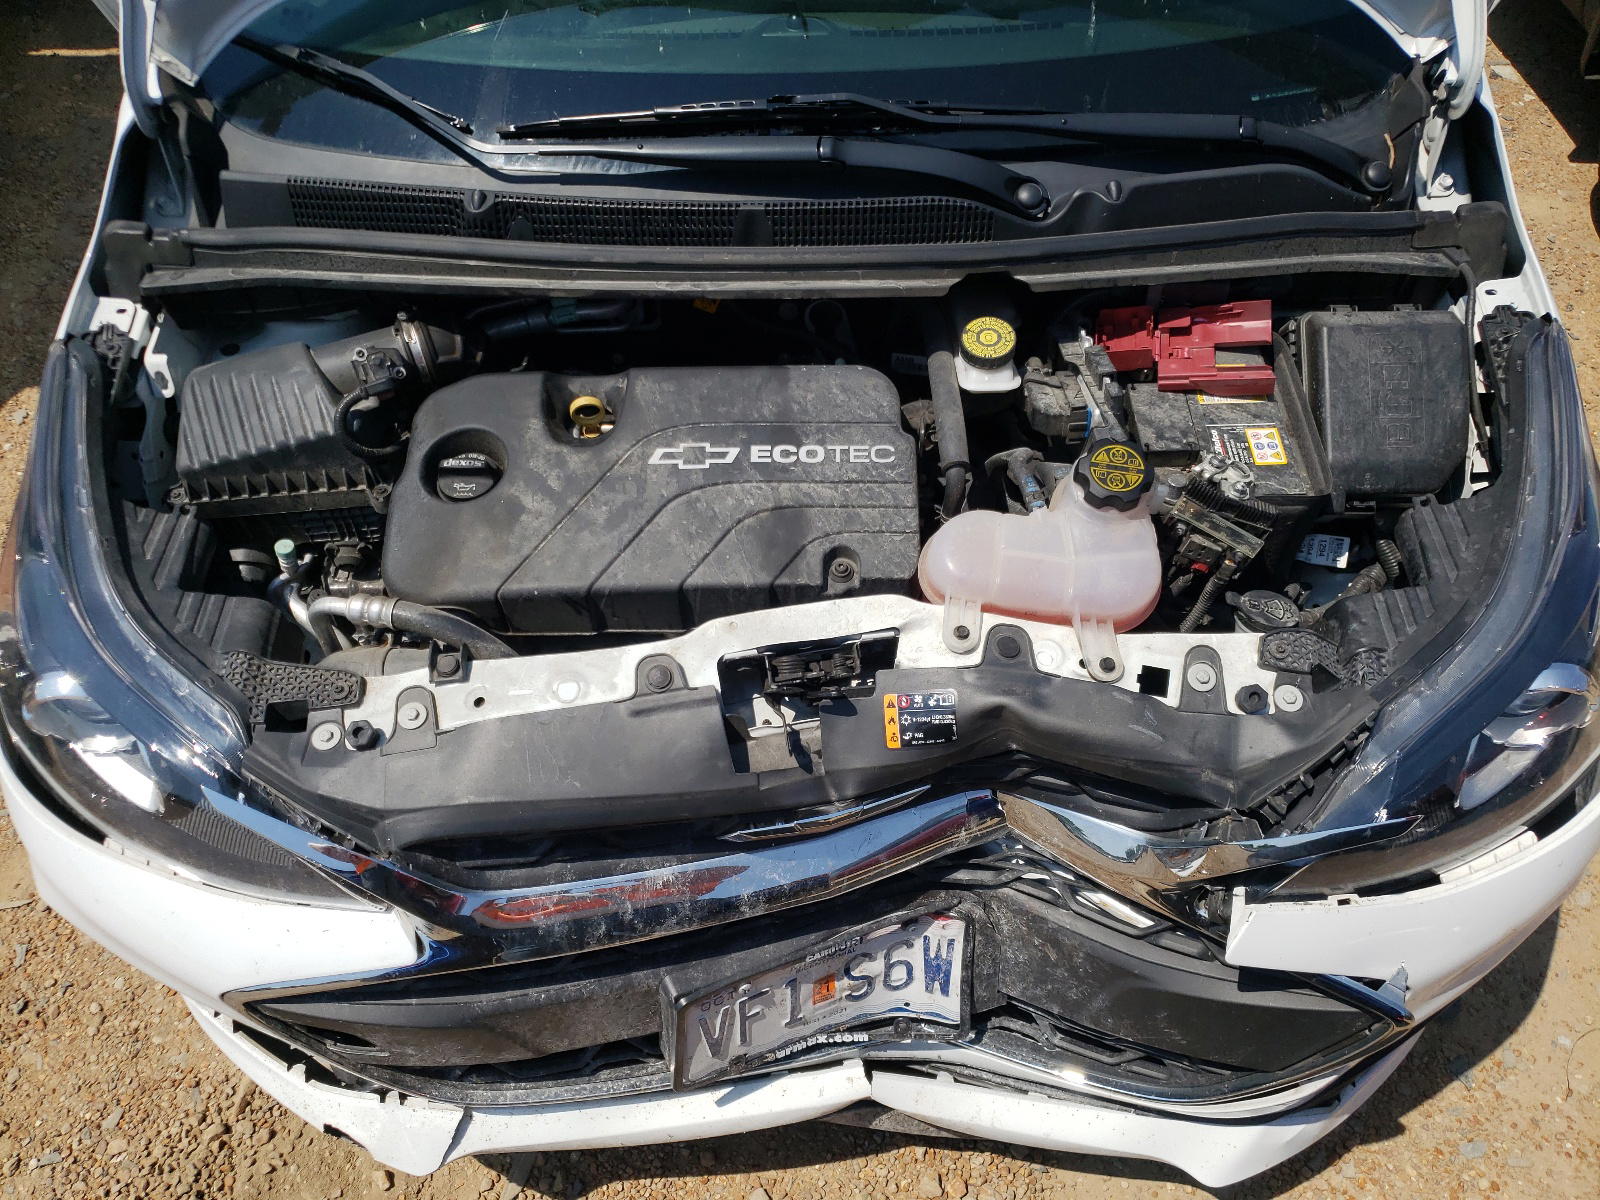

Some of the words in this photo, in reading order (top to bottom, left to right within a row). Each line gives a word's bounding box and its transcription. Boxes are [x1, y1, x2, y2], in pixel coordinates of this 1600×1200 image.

[443, 458, 484, 467] dexos
[751, 444, 896, 464] ECOTEC
[699, 976, 804, 1062] VF1
[843, 934, 956, 1002] S6W
